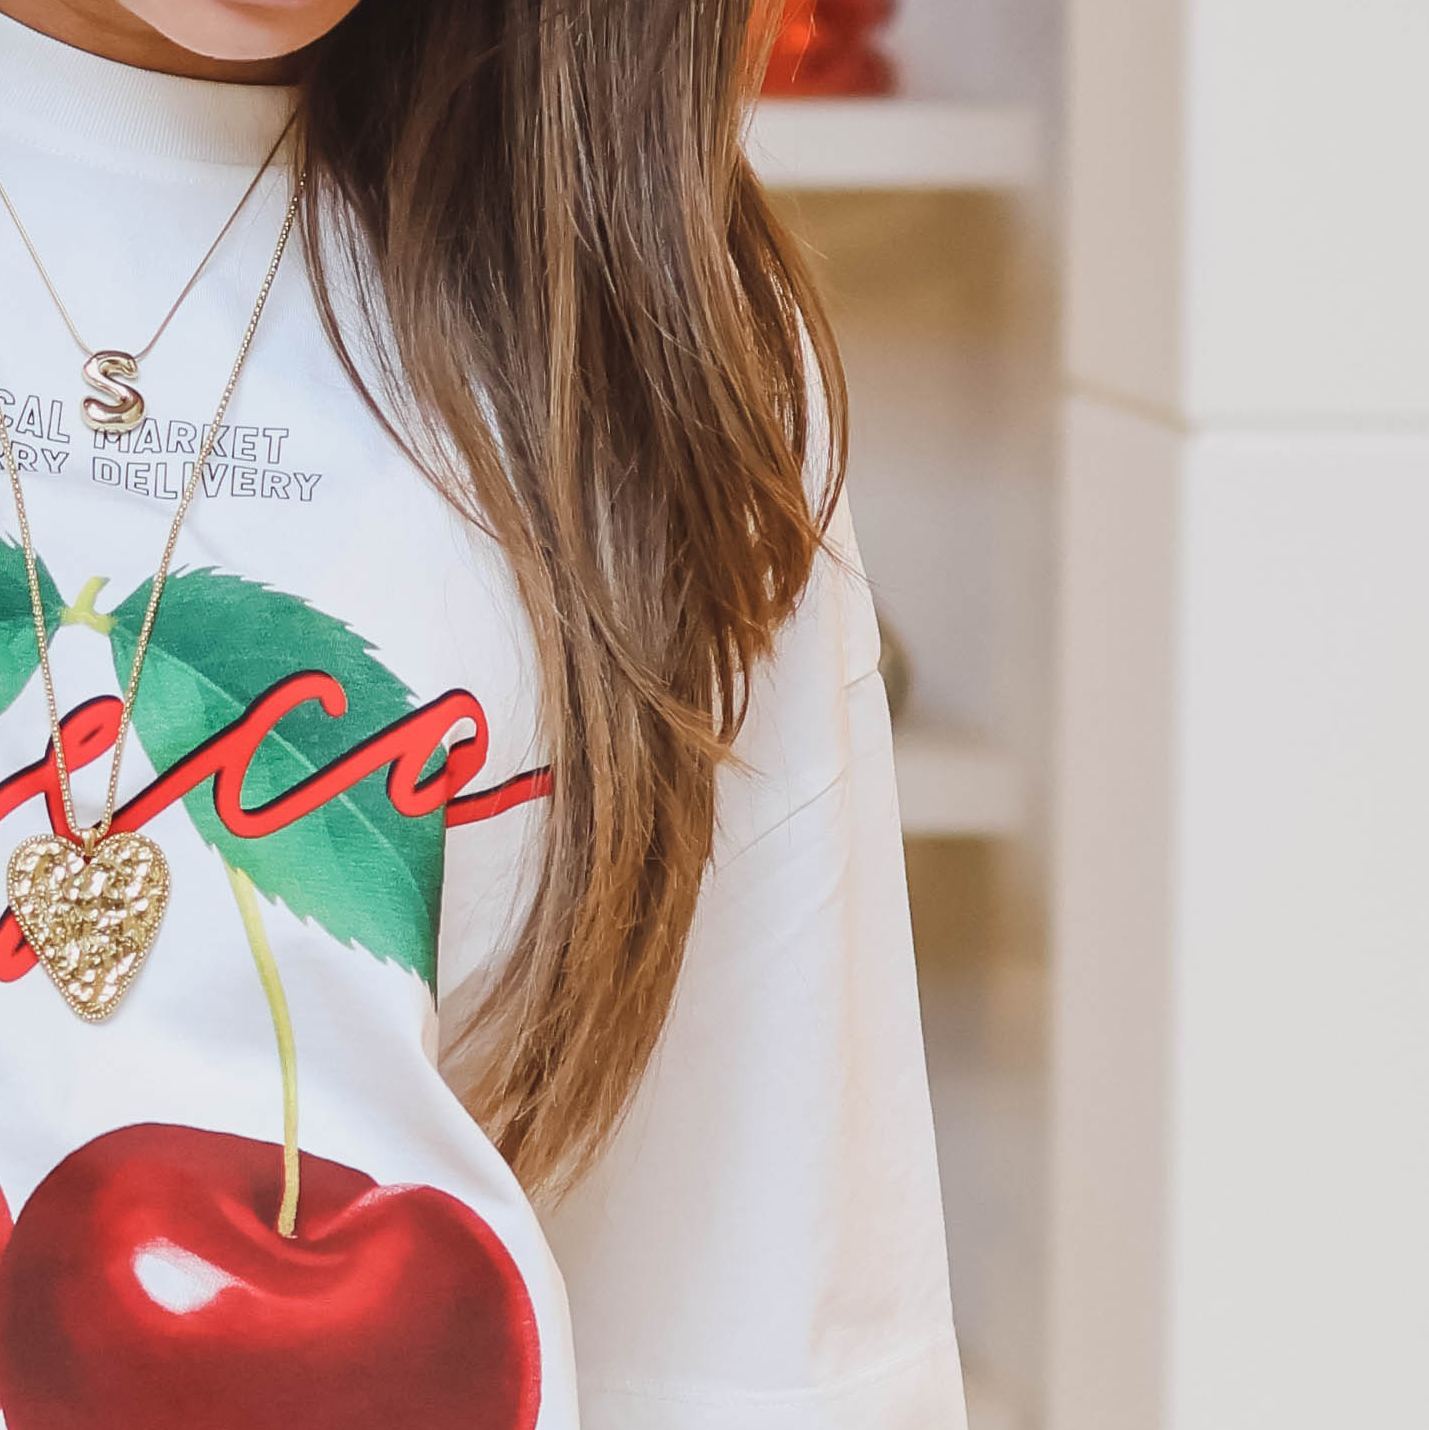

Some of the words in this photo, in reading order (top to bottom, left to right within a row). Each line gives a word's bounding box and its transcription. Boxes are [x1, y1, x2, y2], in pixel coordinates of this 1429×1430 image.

[81, 349, 146, 434] S
[93, 417, 290, 465] MARKET
[91, 456, 323, 502] DELIVERY
